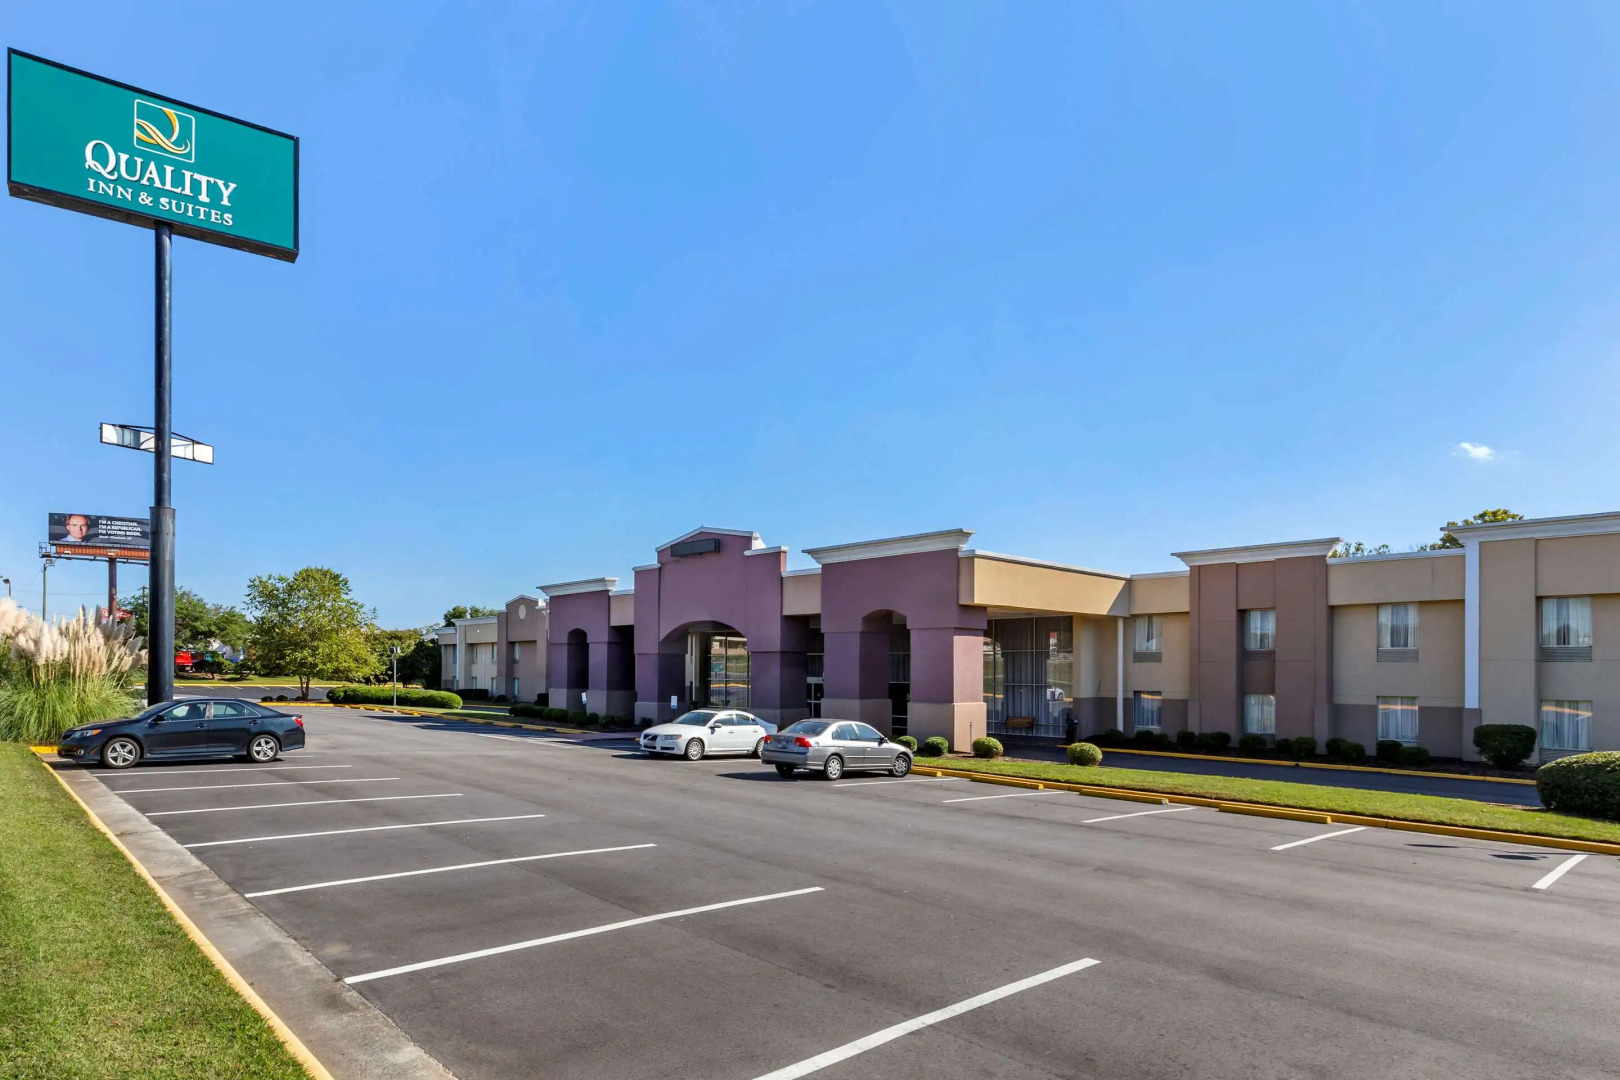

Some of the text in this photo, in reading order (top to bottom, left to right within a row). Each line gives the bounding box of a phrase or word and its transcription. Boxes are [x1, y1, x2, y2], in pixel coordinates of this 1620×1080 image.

[85, 139, 237, 207] QUALITY
[87, 177, 234, 226] INN & SUITES
